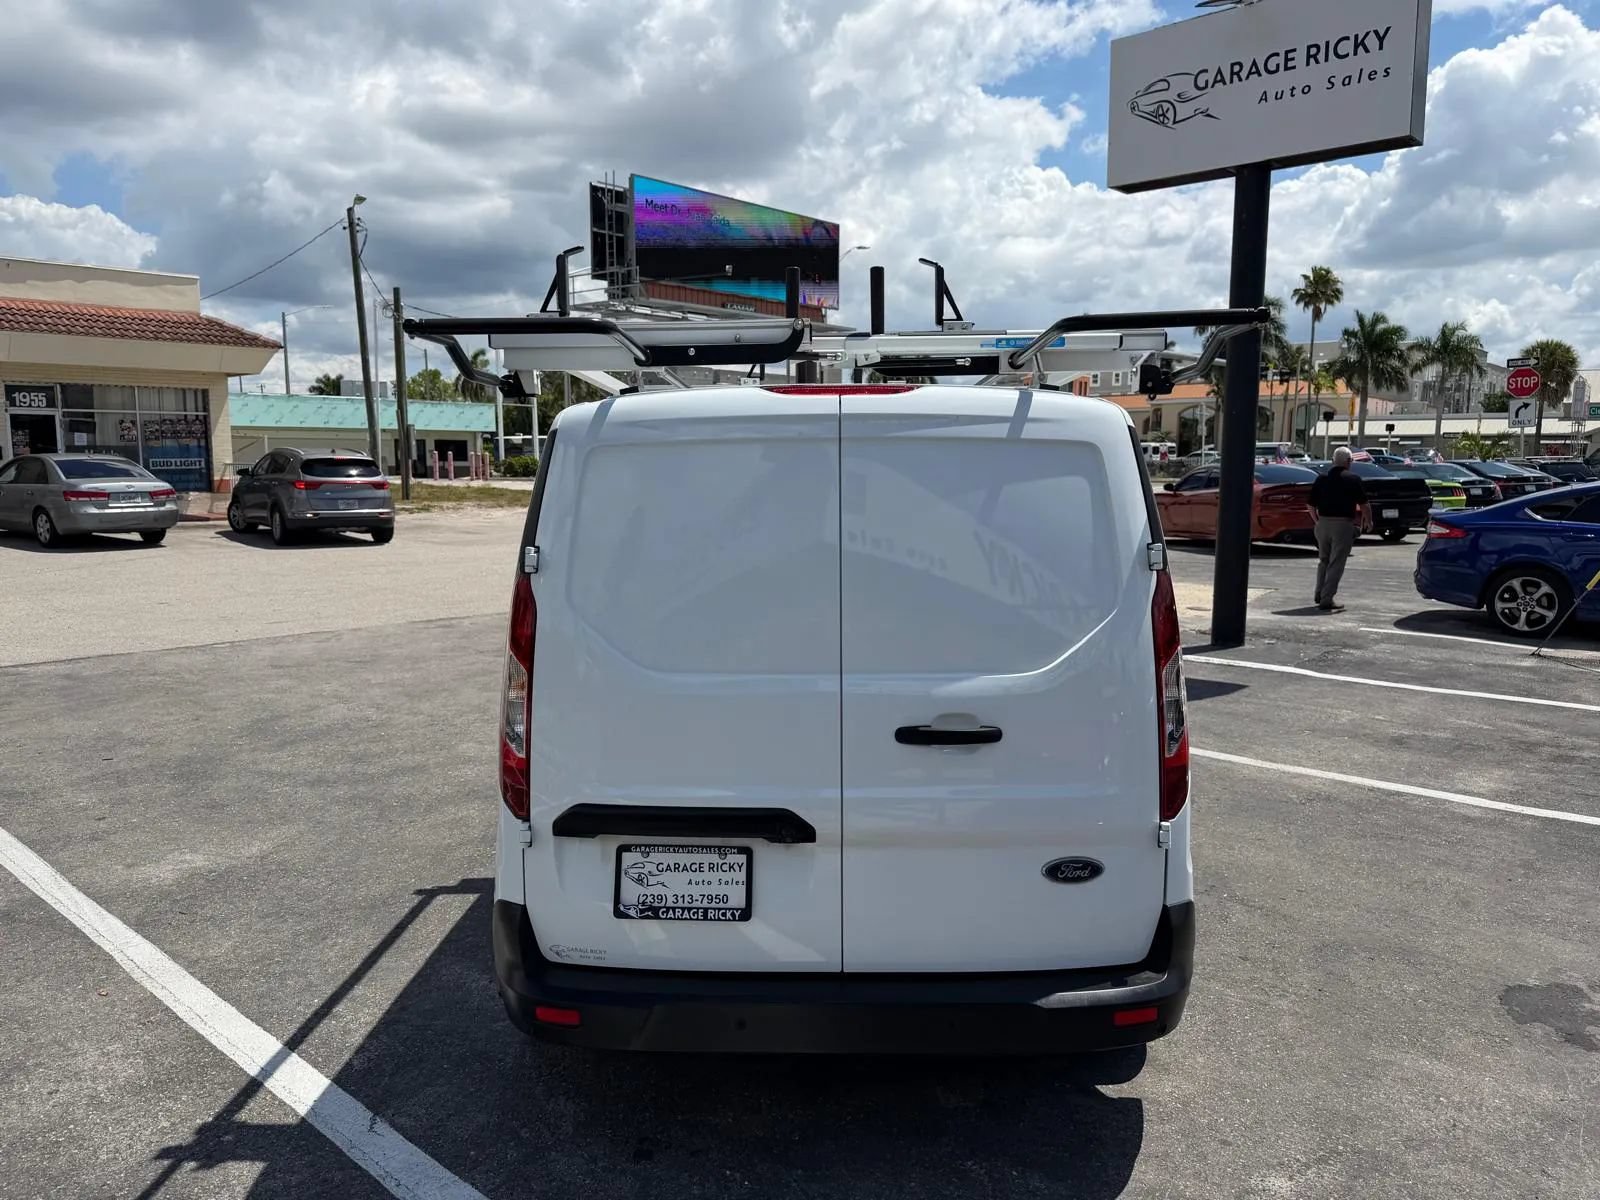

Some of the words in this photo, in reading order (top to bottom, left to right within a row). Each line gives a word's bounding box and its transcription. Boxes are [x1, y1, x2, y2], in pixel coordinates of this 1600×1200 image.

[1193, 48, 1297, 92] GARAGE
[1304, 25, 1392, 67] RICKY
[1257, 84, 1312, 104] Auto
[1325, 66, 1391, 90] Sales
[645, 198, 669, 214] Meet
[1509, 376, 1538, 388] STOP
[12, 391, 47, 407] 1955
[151, 459, 173, 468] BUD
[174, 459, 203, 468] LIGHT
[631, 846, 738, 854] GARAGERICKYAUTOSALES.COM
[656, 862, 705, 873] GARAGE
[708, 862, 744, 873] RICKY
[1057, 863, 1092, 878] Ford
[688, 878, 712, 886] Auto
[717, 878, 745, 886] Sales
[637, 893, 668, 907] (239)
[672, 894, 729, 905] 313-7950
[658, 908, 704, 919] GARAGE
[707, 909, 741, 920] RICKY
